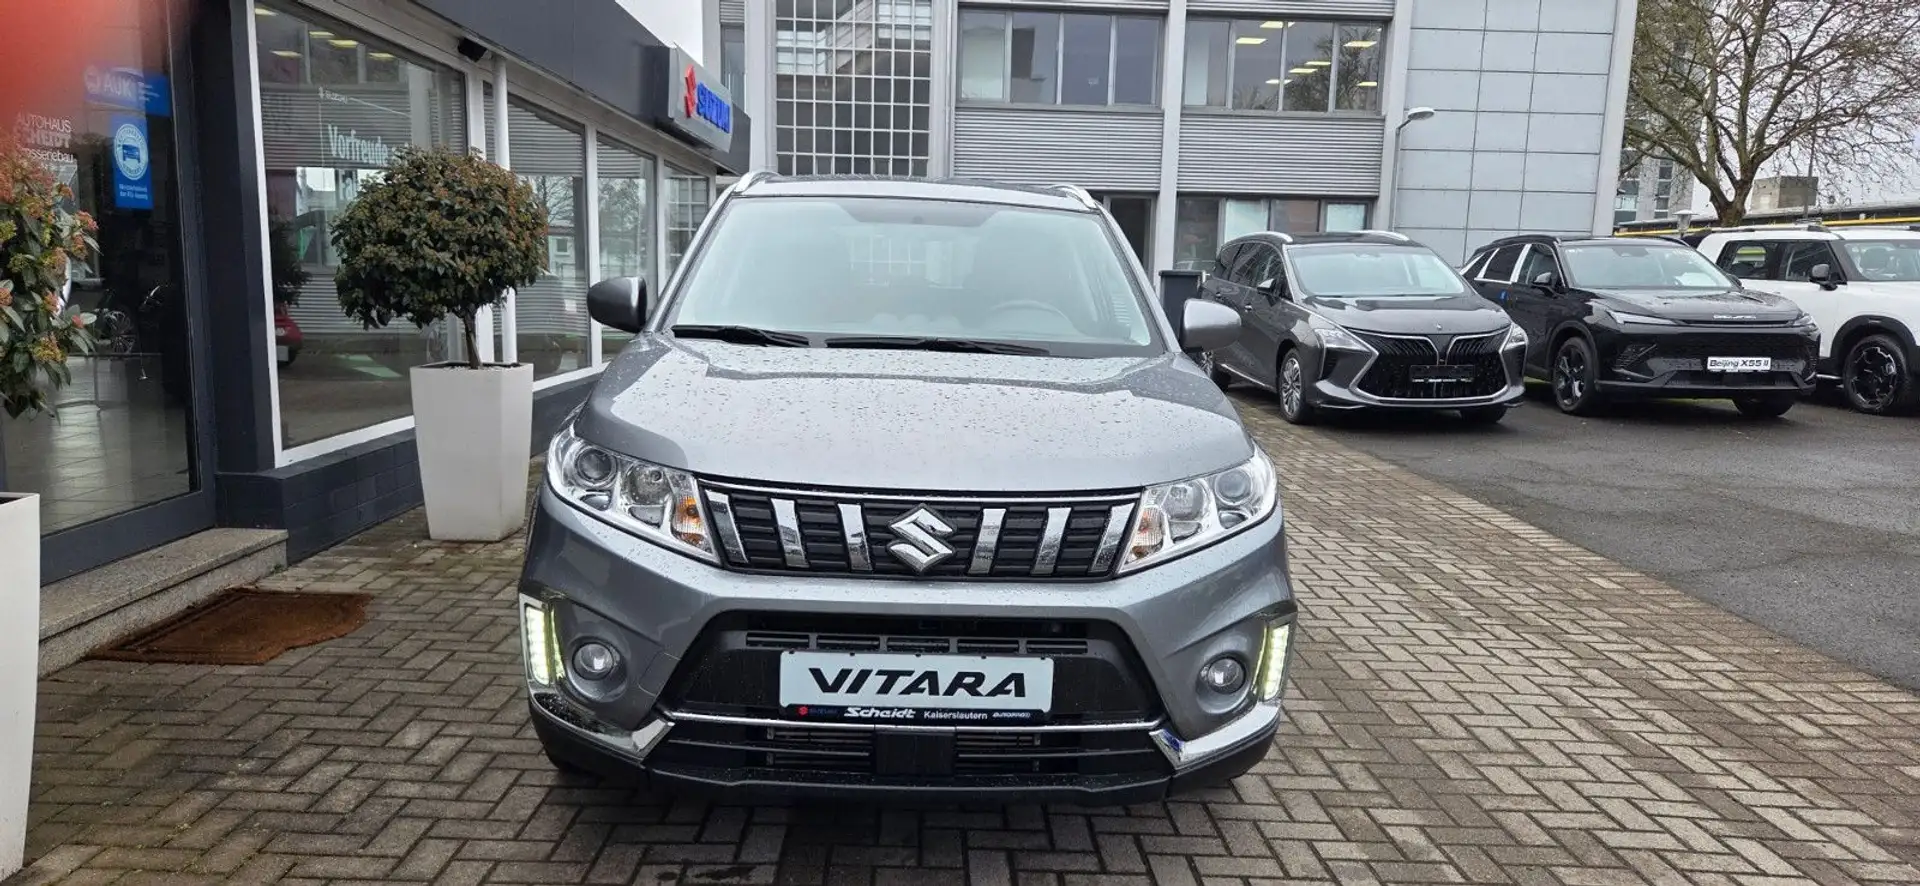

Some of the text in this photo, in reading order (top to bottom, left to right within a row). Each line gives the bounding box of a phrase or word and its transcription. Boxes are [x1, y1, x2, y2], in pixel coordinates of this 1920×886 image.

[16, 111, 72, 132] AUTOHAUS
[328, 123, 389, 168] Vorfreude
[808, 667, 1026, 698] VITARA
[843, 706, 916, 718] Scheidt
[923, 710, 988, 720] Kaiserslautern
